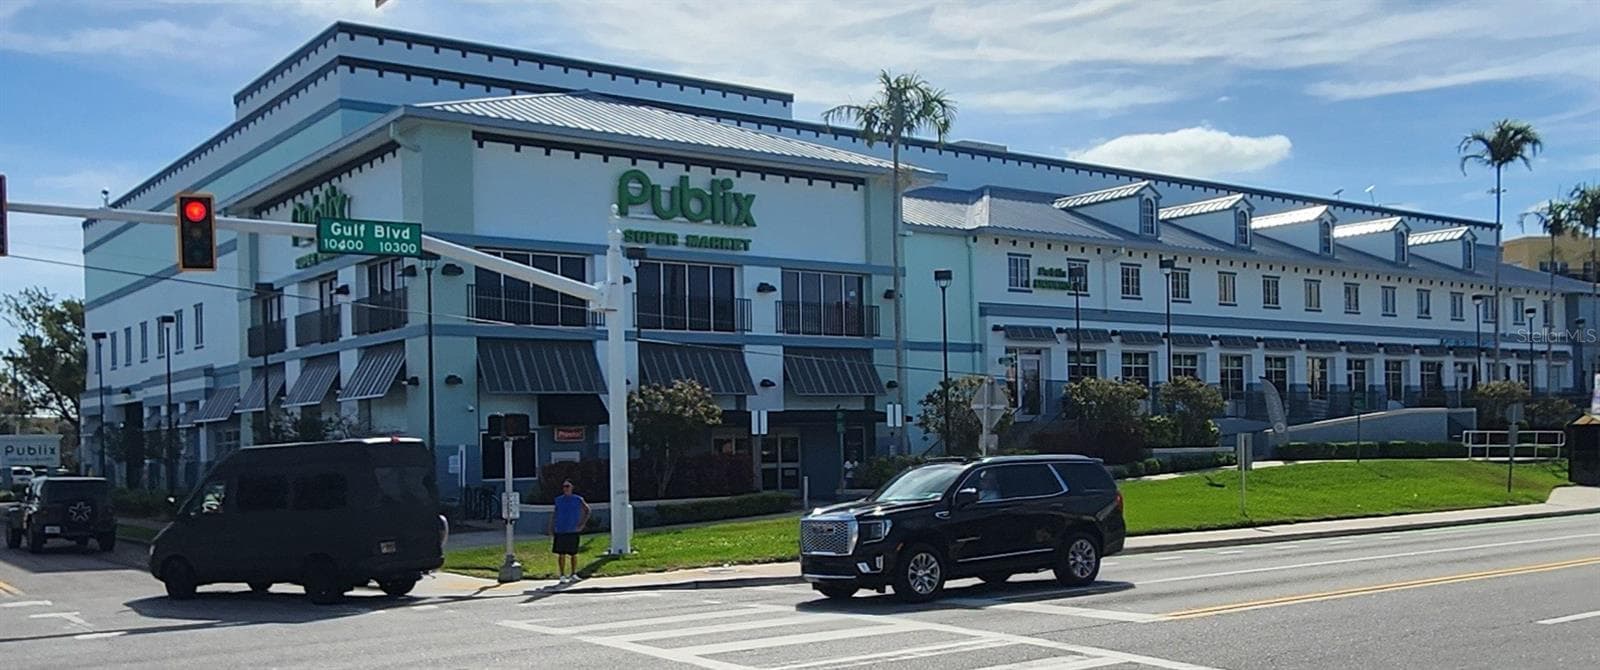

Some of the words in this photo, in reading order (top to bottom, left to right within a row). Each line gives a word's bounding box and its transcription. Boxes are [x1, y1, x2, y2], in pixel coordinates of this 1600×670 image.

[618, 169, 757, 227] Publix
[331, 222, 365, 237] Gulf
[374, 225, 411, 240] Blvd
[324, 238, 364, 251] 10400
[379, 242, 417, 254] 10300
[623, 229, 679, 246] SUPER
[685, 234, 752, 252] MARKET
[5, 444, 56, 456] Publix
